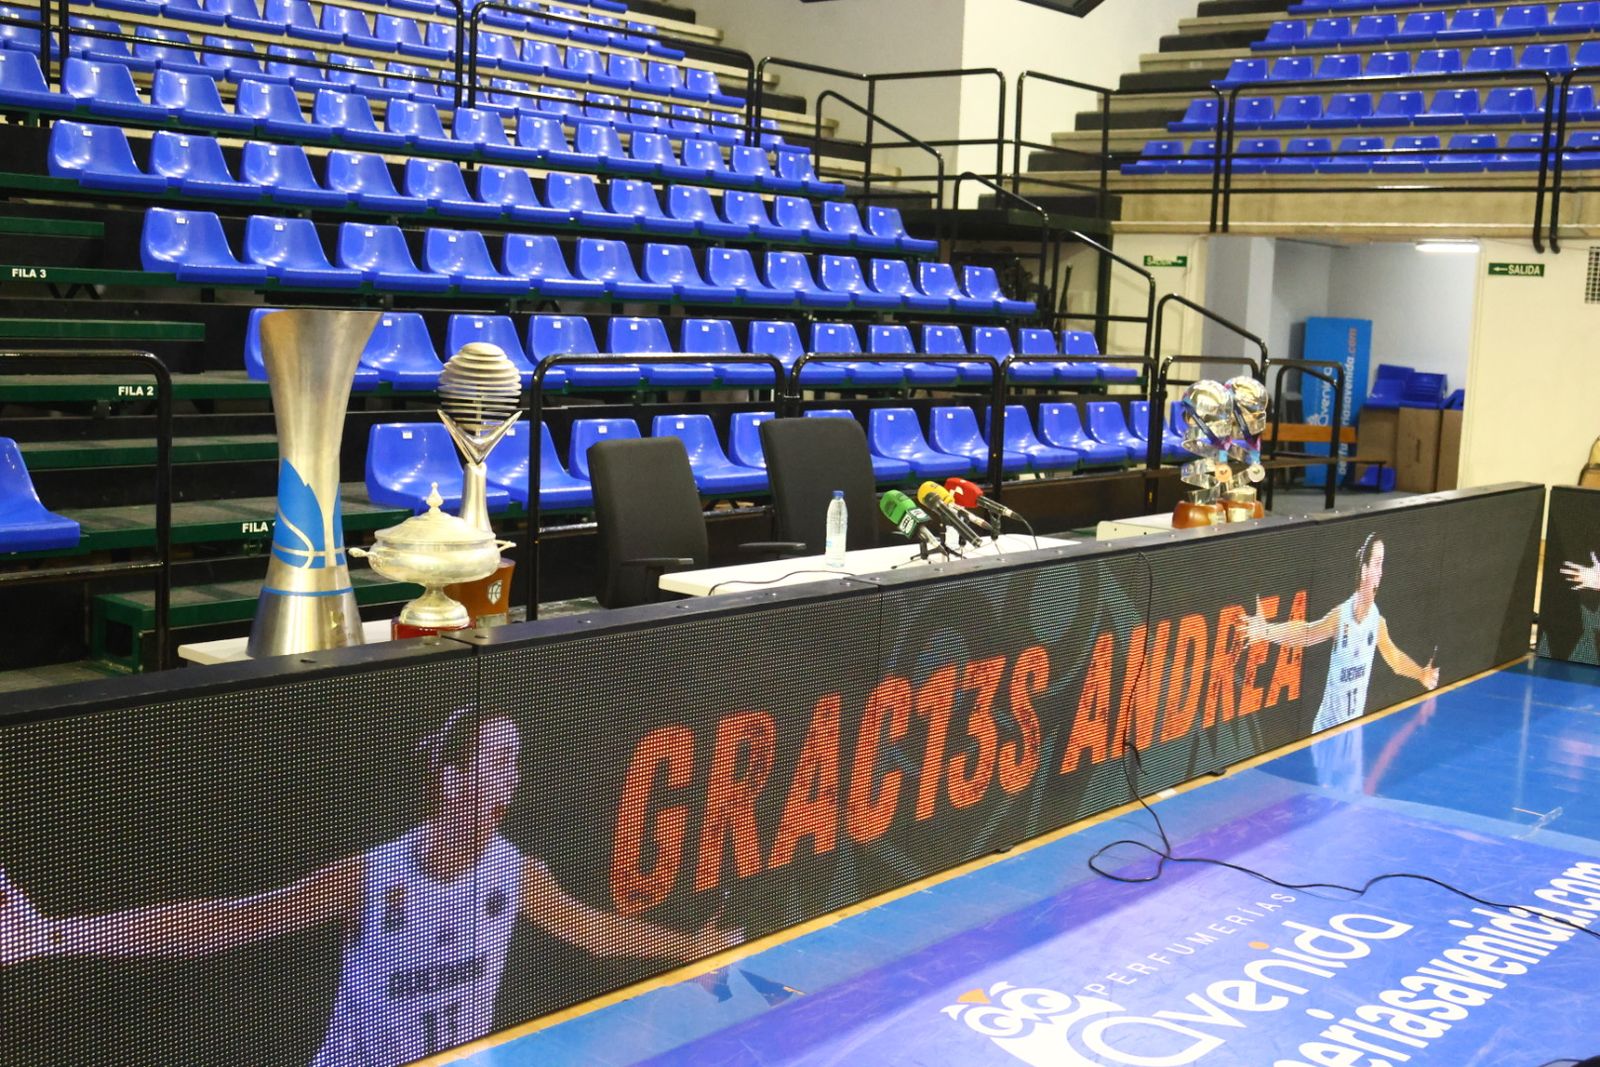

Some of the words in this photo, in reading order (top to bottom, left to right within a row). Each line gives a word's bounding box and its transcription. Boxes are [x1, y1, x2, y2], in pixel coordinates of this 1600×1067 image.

[12, 268, 37, 278] FILA
[39, 268, 47, 279] 3
[1508, 264, 1540, 275] SALIDA
[118, 386, 144, 396] FILA
[146, 386, 154, 396] 2
[242, 521, 269, 533] FILA
[1060, 589, 1307, 775] ANDREA
[1083, 892, 1297, 996] PERFUMERÍAS
